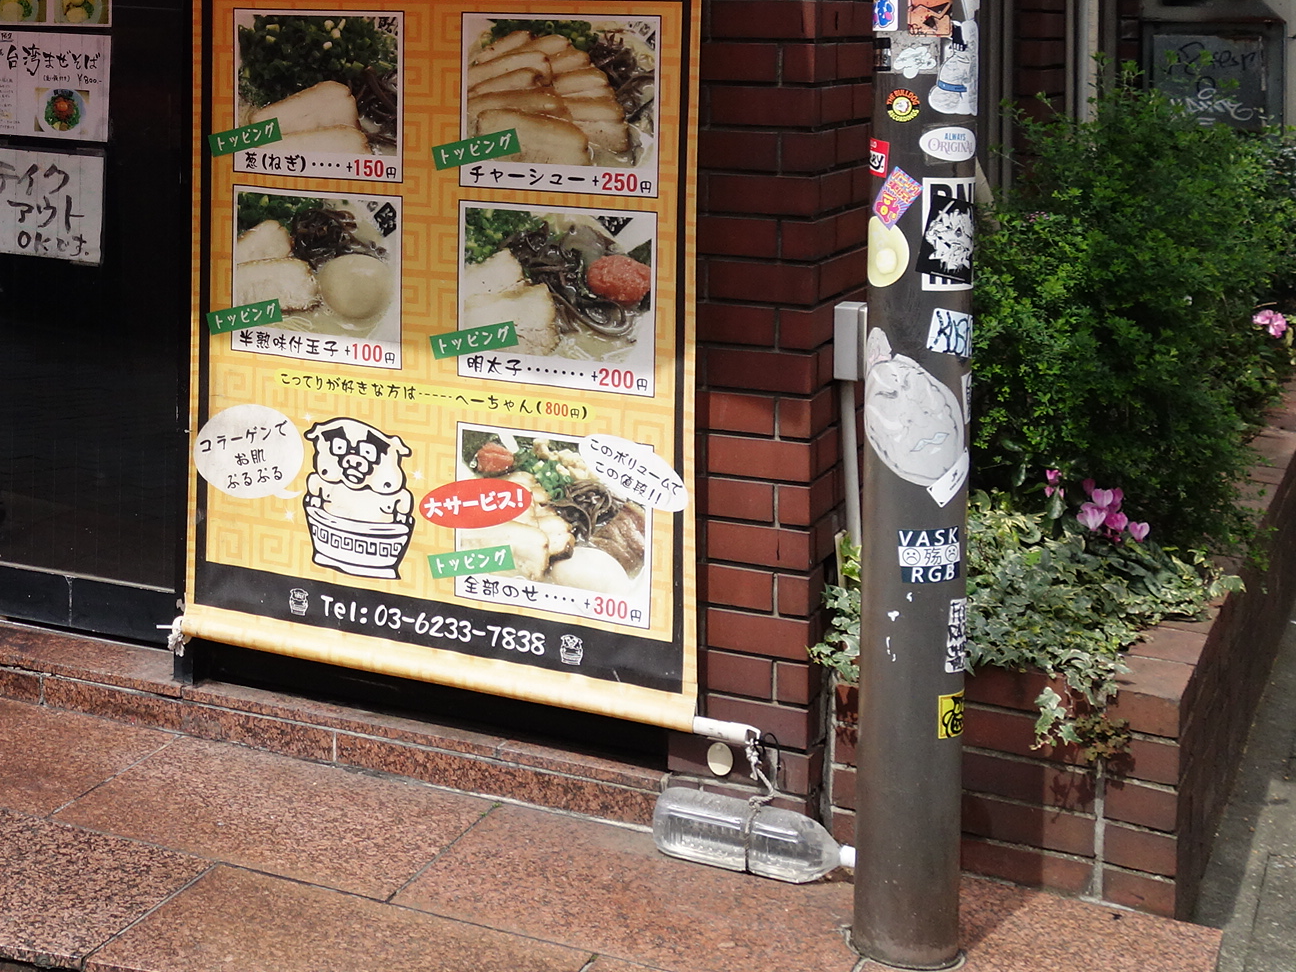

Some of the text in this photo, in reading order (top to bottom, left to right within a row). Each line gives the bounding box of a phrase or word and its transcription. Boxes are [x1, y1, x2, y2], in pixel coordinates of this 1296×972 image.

[6, 43, 101, 76] 台湾まぜそば
[215, 122, 276, 153] トッピング
[440, 132, 513, 166] トッピング
[944, 132, 966, 141] ALWAYS
[469, 165, 653, 195] チャーシュー +250円
[6, 195, 85, 231] アウト
[214, 302, 276, 331] トッピング
[239, 330, 396, 366] 半熟味付玉子 +100円
[438, 324, 512, 355] トッピング
[466, 356, 521, 377] 明太子
[279, 371, 417, 403] こってりが好きな方は
[198, 421, 288, 454] コラーゲンで
[234, 449, 267, 467] お肌
[424, 491, 526, 519] 大サービス!
[898, 527, 958, 547] VASK
[435, 550, 507, 576] トッピング
[911, 564, 955, 583] RGB
[463, 576, 540, 604] 全部のせ
[320, 594, 546, 656] Tel: 03-6233-7838
